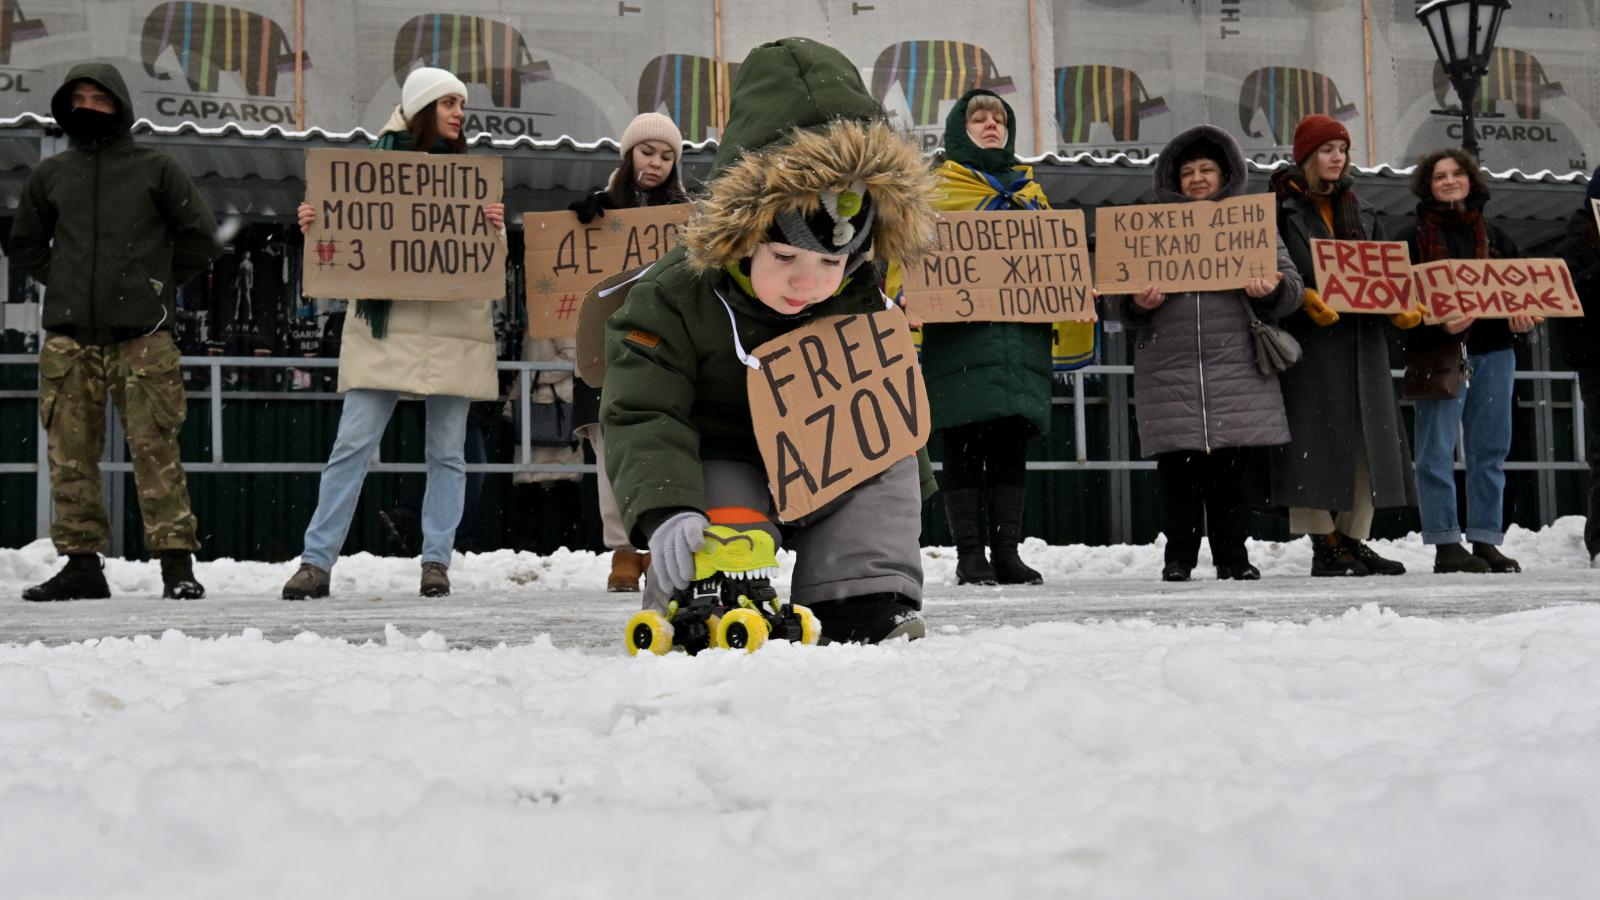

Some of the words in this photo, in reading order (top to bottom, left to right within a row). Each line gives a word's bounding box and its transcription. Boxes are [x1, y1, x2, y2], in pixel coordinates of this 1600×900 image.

[330, 161, 488, 200] ПОВЕРНІТЬ
[323, 200, 394, 231] МОГО
[412, 203, 488, 236] БРАТА
[1114, 209, 1194, 232] КОЖЕН
[1208, 203, 1265, 228] ДЕНЬ
[347, 239, 366, 271] З
[390, 239, 496, 275] ПОЛОНУ
[552, 228, 603, 277] ДЕ
[1124, 233, 1200, 258] ЧЕКАЮ
[1215, 228, 1269, 252] СИНА
[1316, 240, 1409, 279] FREE
[923, 255, 981, 287] МОЄ
[1001, 253, 1083, 284] ЖИТТЯ
[1148, 255, 1245, 281] ПОЛОНУ
[999, 285, 1087, 316] ПОЛОНУ
[1321, 273, 1412, 311] AZOV
[760, 313, 903, 418] FREE
[776, 366, 918, 512] AZOV
